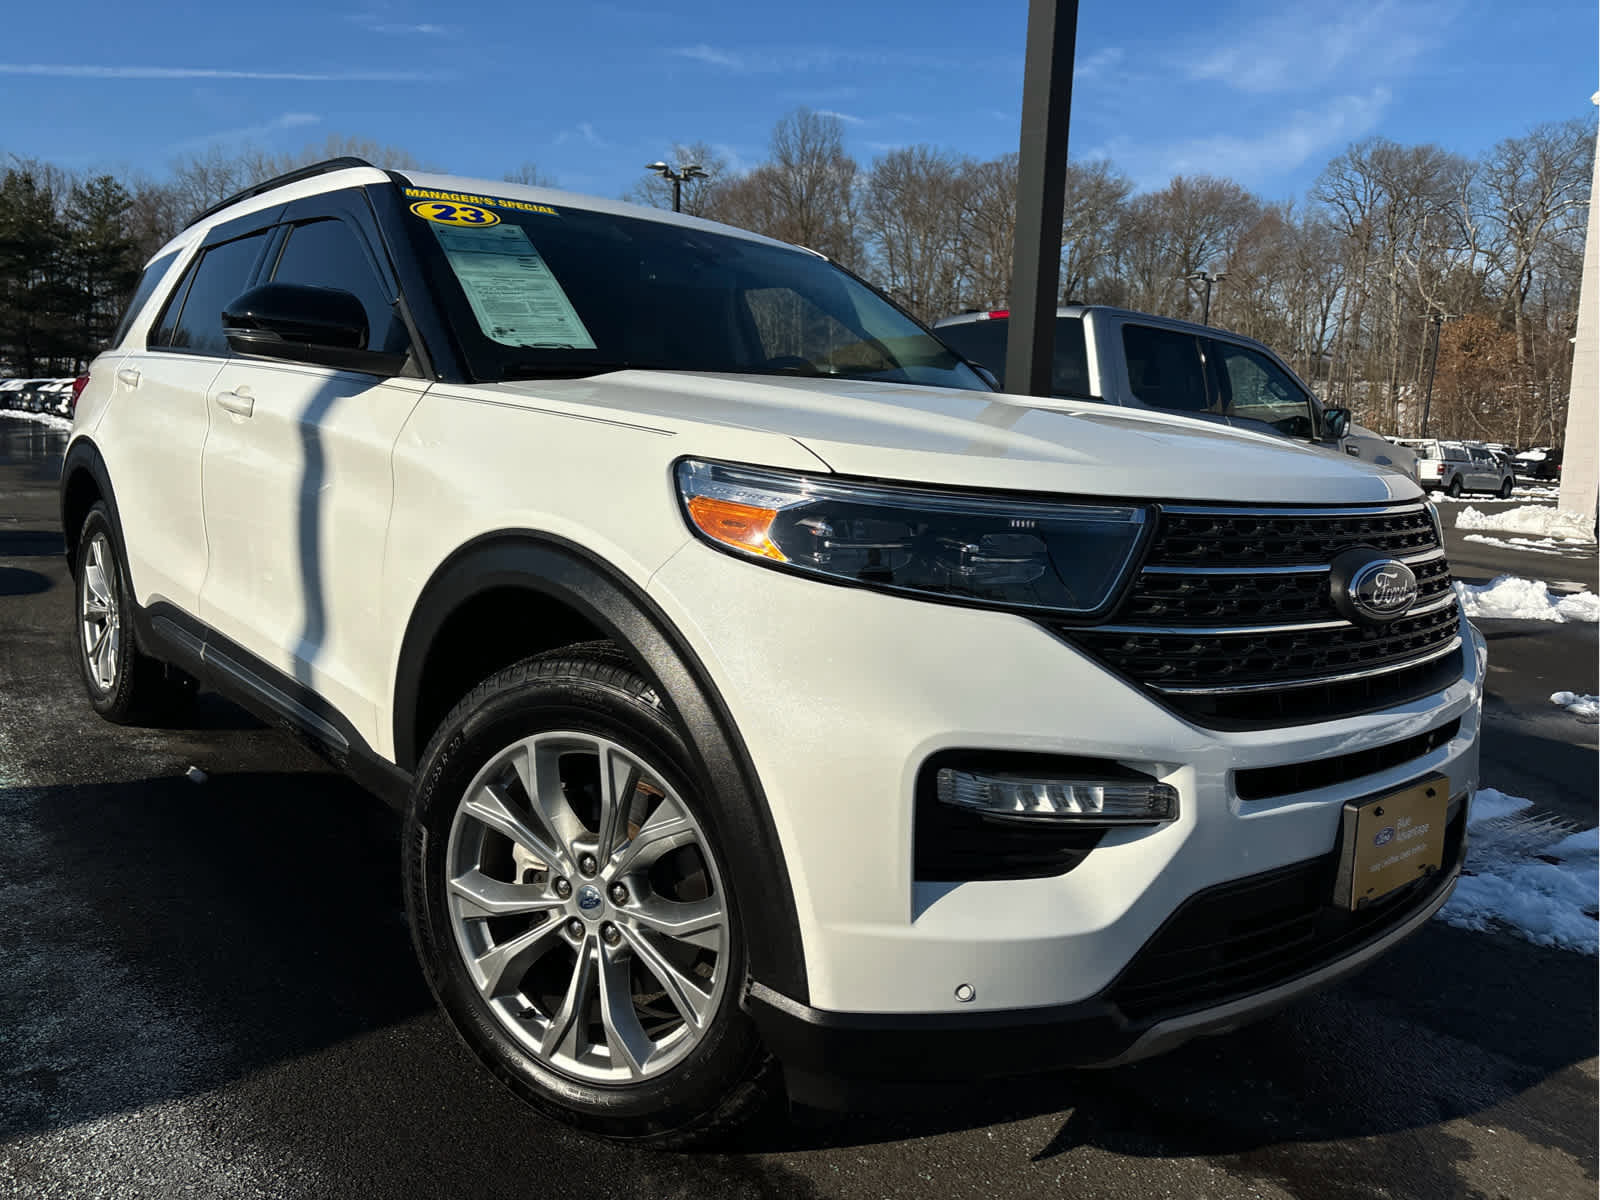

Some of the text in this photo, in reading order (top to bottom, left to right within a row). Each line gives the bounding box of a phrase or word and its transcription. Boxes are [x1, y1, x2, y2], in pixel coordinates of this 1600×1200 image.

[405, 188, 559, 216] MANAGER'S SPECIAL
[431, 204, 486, 224] 23
[1372, 571, 1412, 605] Ford
